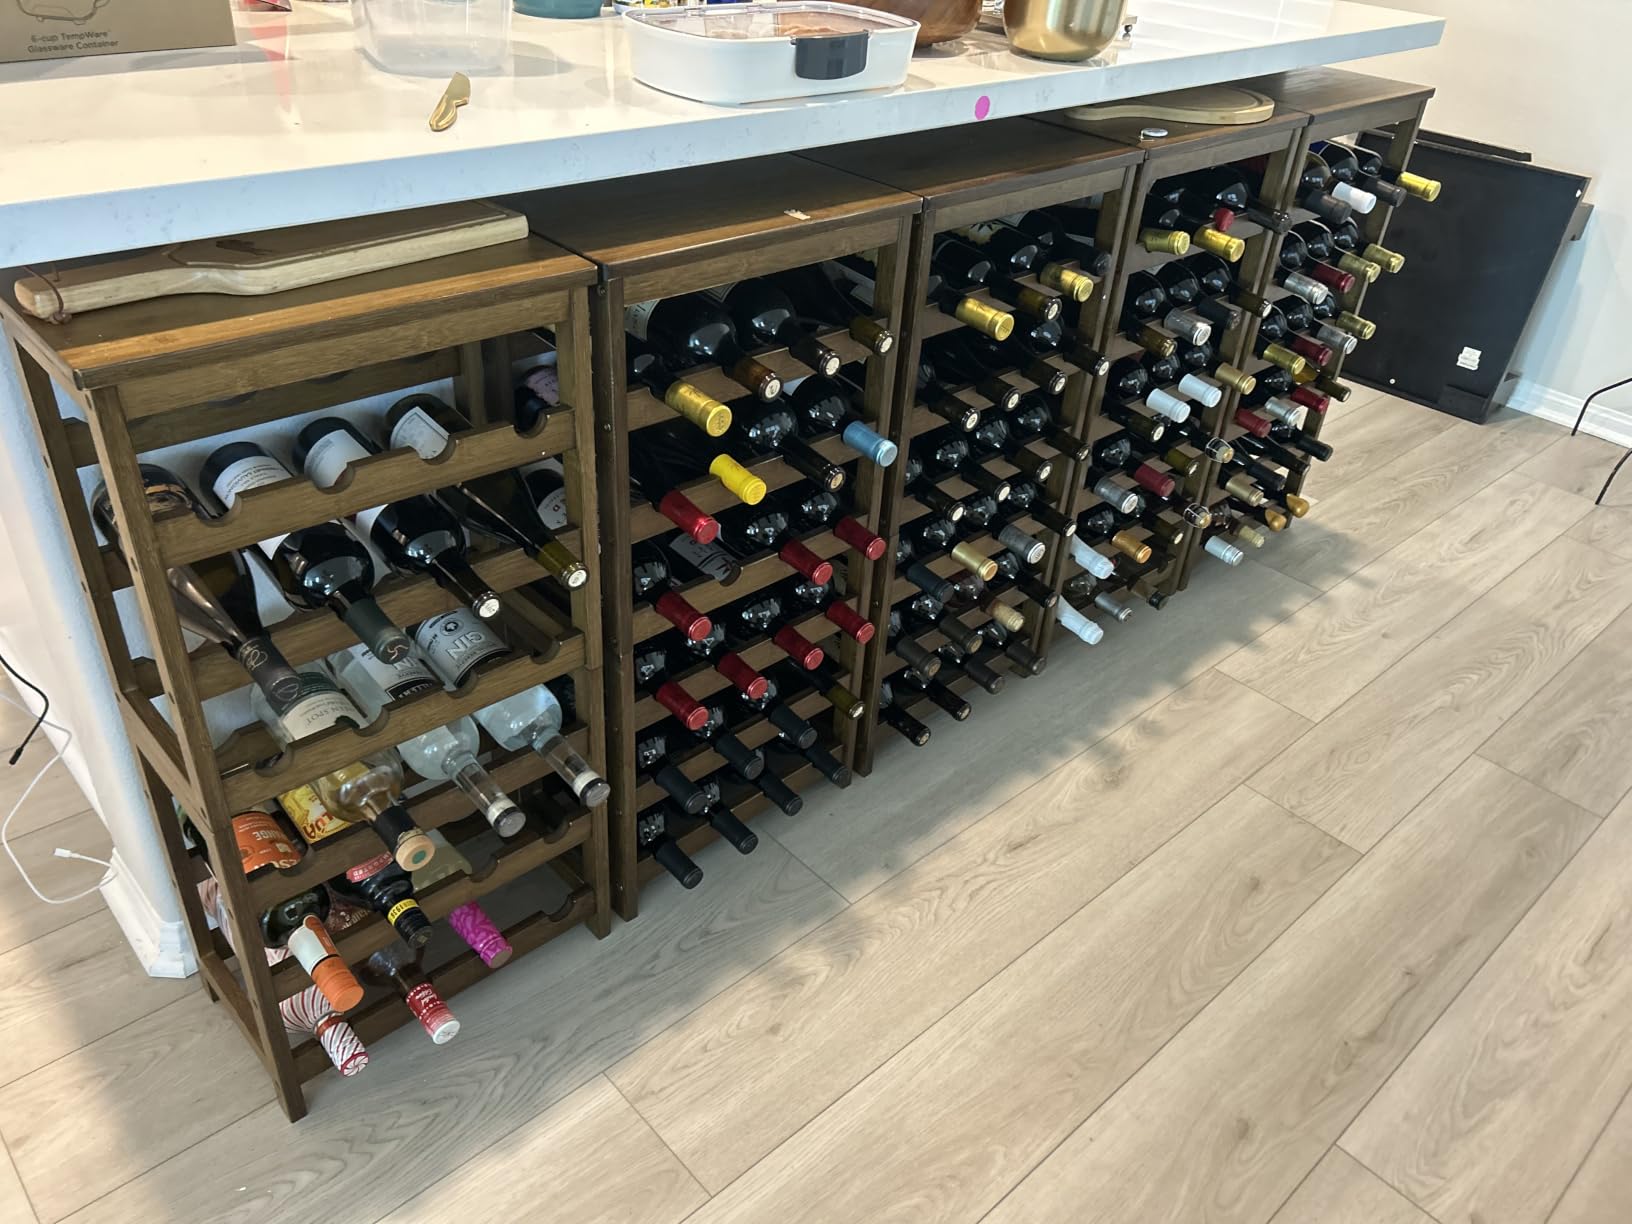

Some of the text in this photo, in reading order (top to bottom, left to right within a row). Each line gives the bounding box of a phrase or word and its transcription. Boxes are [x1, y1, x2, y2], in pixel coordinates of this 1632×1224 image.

[27, 40, 119, 53] Glassware Container
[445, 631, 484, 660] GIN
